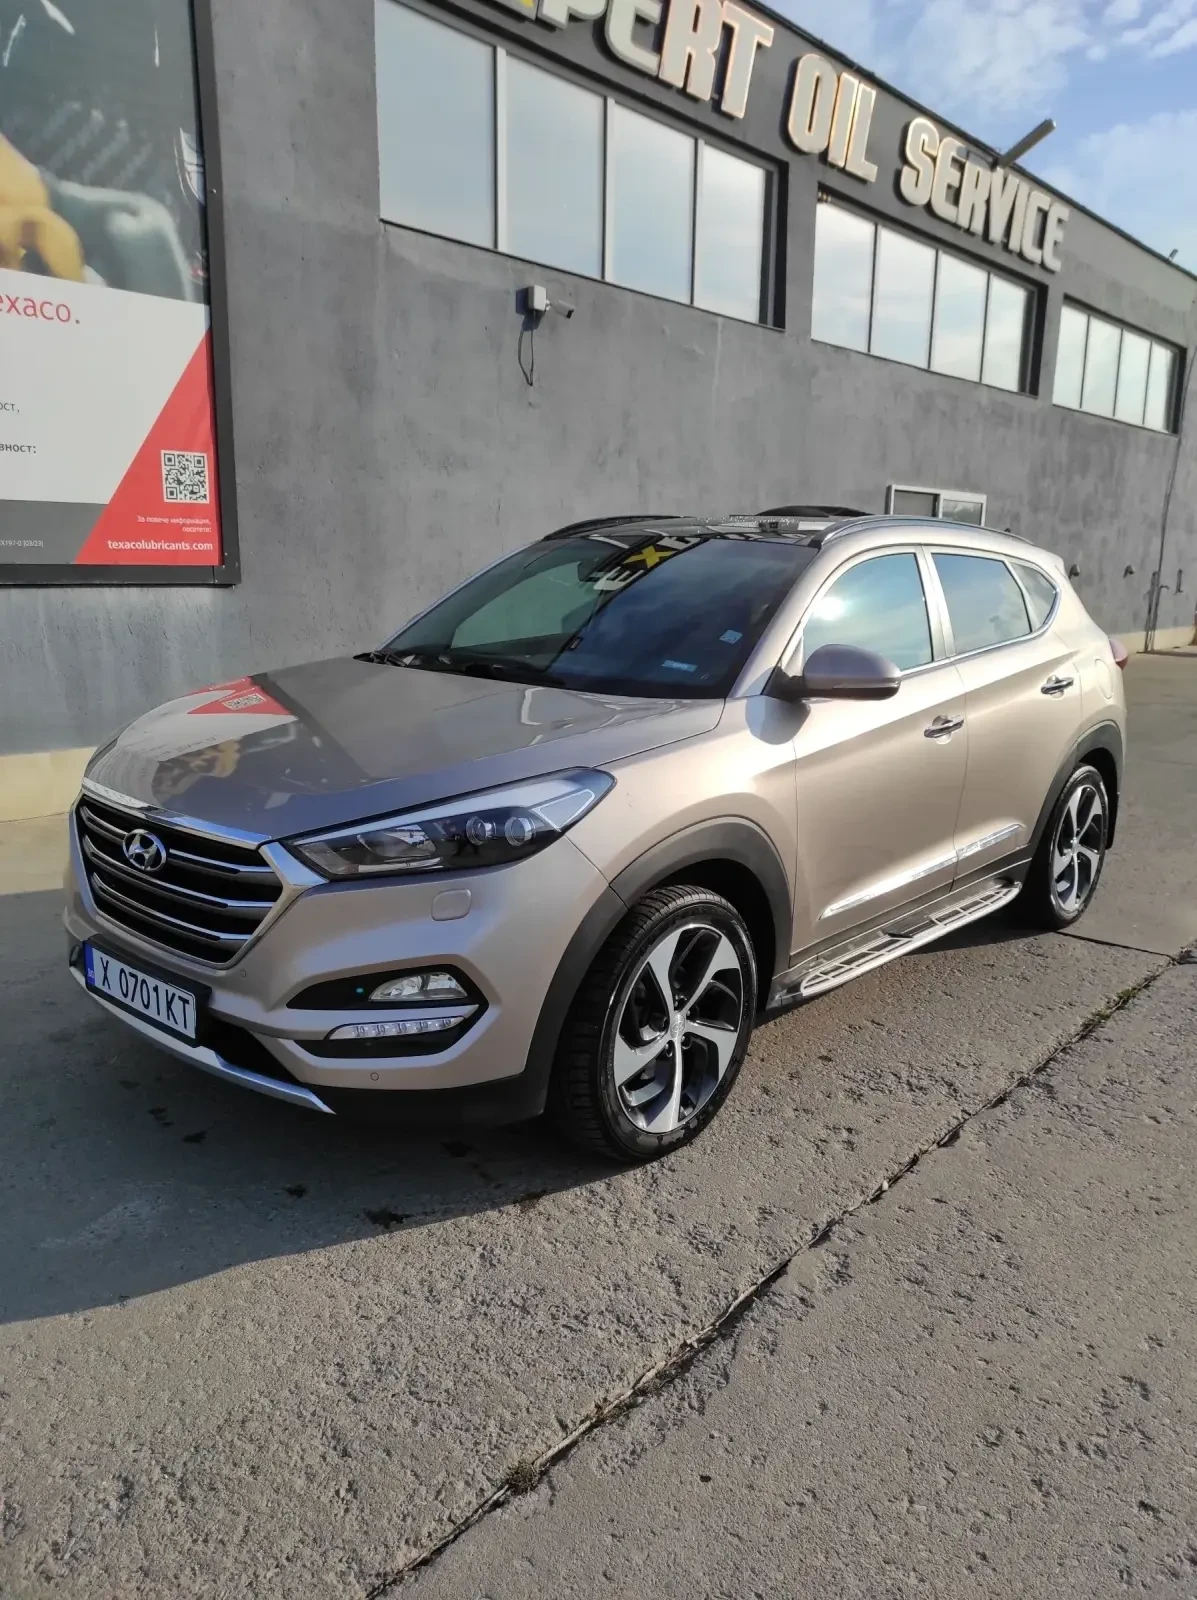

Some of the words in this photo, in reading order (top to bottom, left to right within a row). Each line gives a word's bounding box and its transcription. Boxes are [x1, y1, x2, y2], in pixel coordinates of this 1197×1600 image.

[787, 53, 879, 183] OIL
[898, 116, 1070, 273] SERVICE
[107, 540, 214, 551] texacolubricants.com
